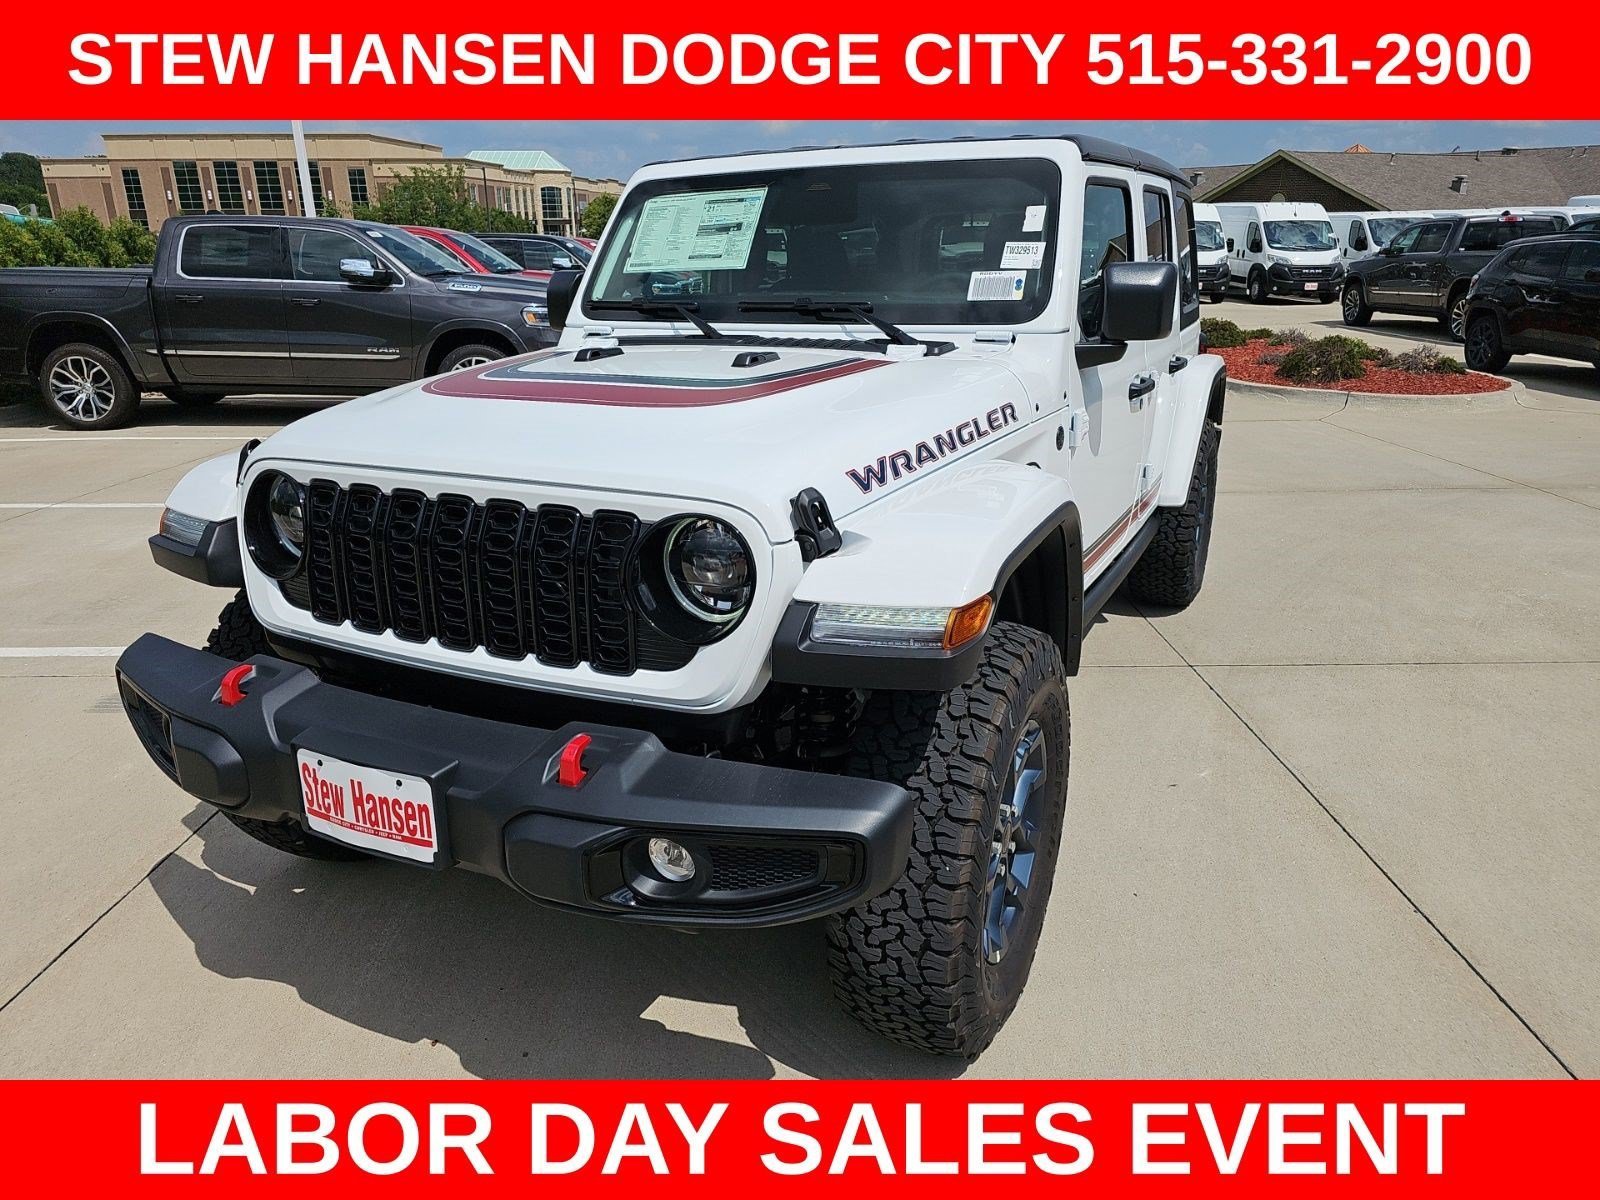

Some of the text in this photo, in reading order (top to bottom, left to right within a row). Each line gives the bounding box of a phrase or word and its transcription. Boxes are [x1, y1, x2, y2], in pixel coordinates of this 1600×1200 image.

[1005, 245, 1039, 255] TW329513
[845, 401, 1019, 494] WRANGLER
[302, 762, 433, 839] Stew Hansen
